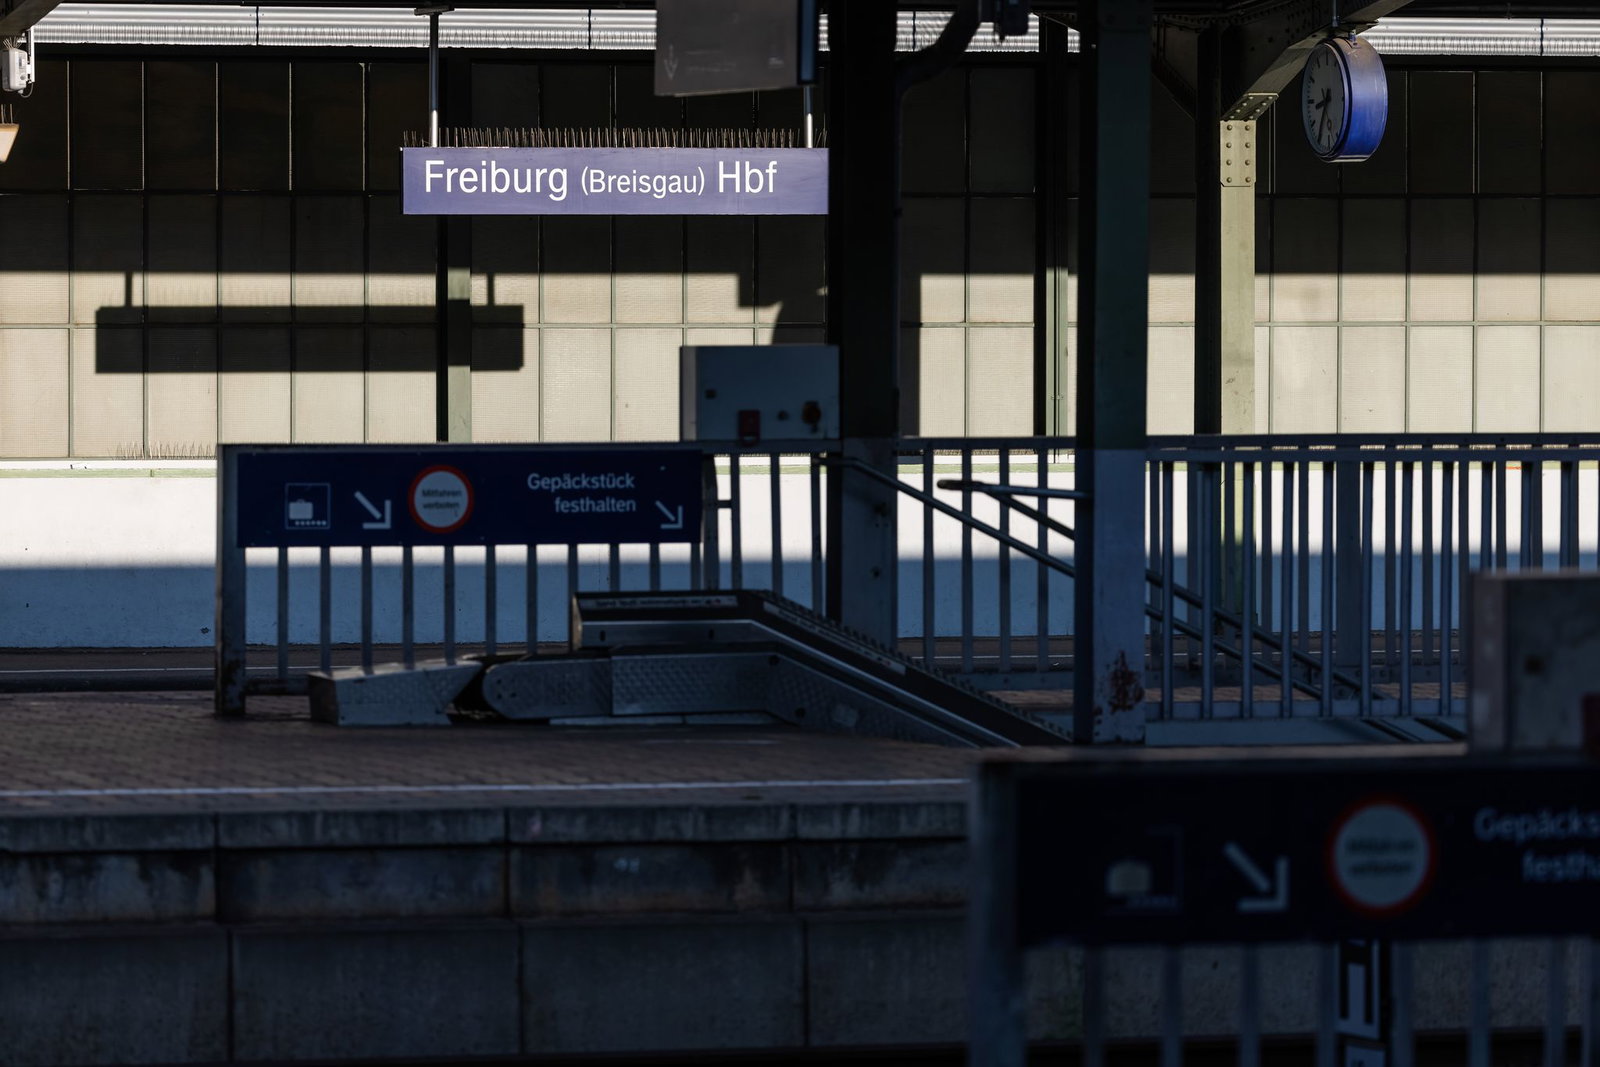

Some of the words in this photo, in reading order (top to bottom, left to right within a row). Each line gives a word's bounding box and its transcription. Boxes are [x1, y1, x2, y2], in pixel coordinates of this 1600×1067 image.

[425, 160, 568, 201] Freiburg
[581, 167, 705, 199] (Breisgau)
[718, 160, 778, 194] Hbf
[527, 472, 636, 493] Gepäckstück
[554, 496, 637, 513] festhalten
